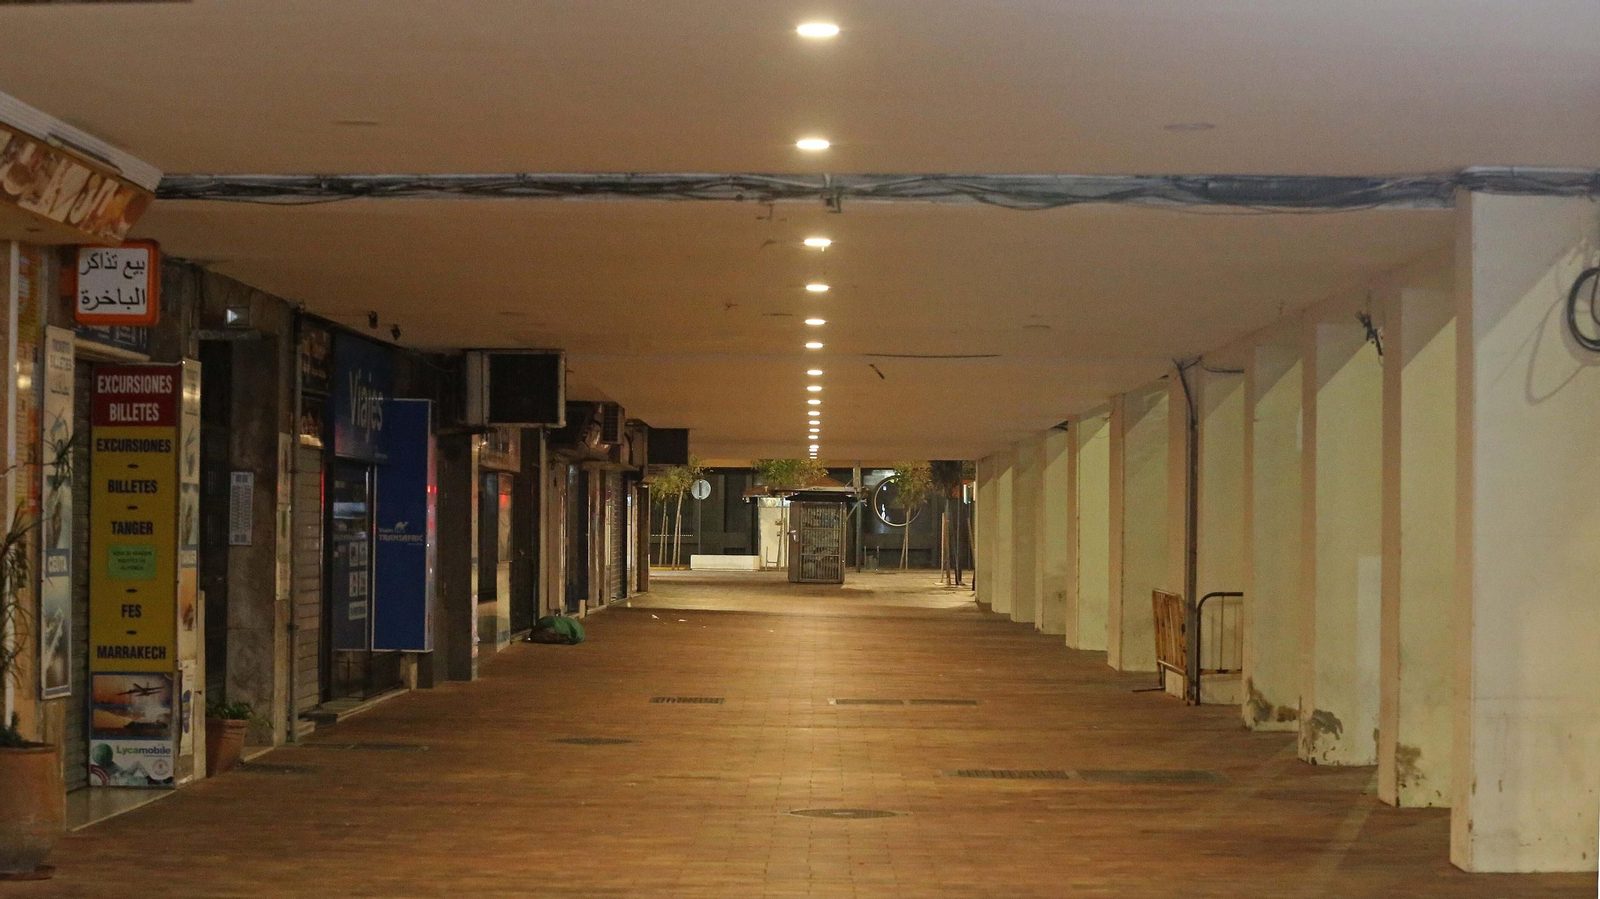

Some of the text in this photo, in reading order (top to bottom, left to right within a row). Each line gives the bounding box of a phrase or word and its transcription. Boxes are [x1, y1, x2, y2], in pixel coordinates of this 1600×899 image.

[79, 251, 145, 279] بيع تذاكر
[81, 286, 146, 311] الباخرة
[97, 374, 173, 394] EXCURSIONES
[109, 403, 160, 422] BILLETES
[349, 367, 384, 443] Viajes
[96, 438, 171, 453] EXCURSIONES
[107, 479, 158, 494] BILLETES
[111, 520, 154, 535] TANGER
[121, 603, 142, 618] FES
[96, 645, 167, 660] MARRAKECH
[116, 745, 171, 756] Lycamobile
